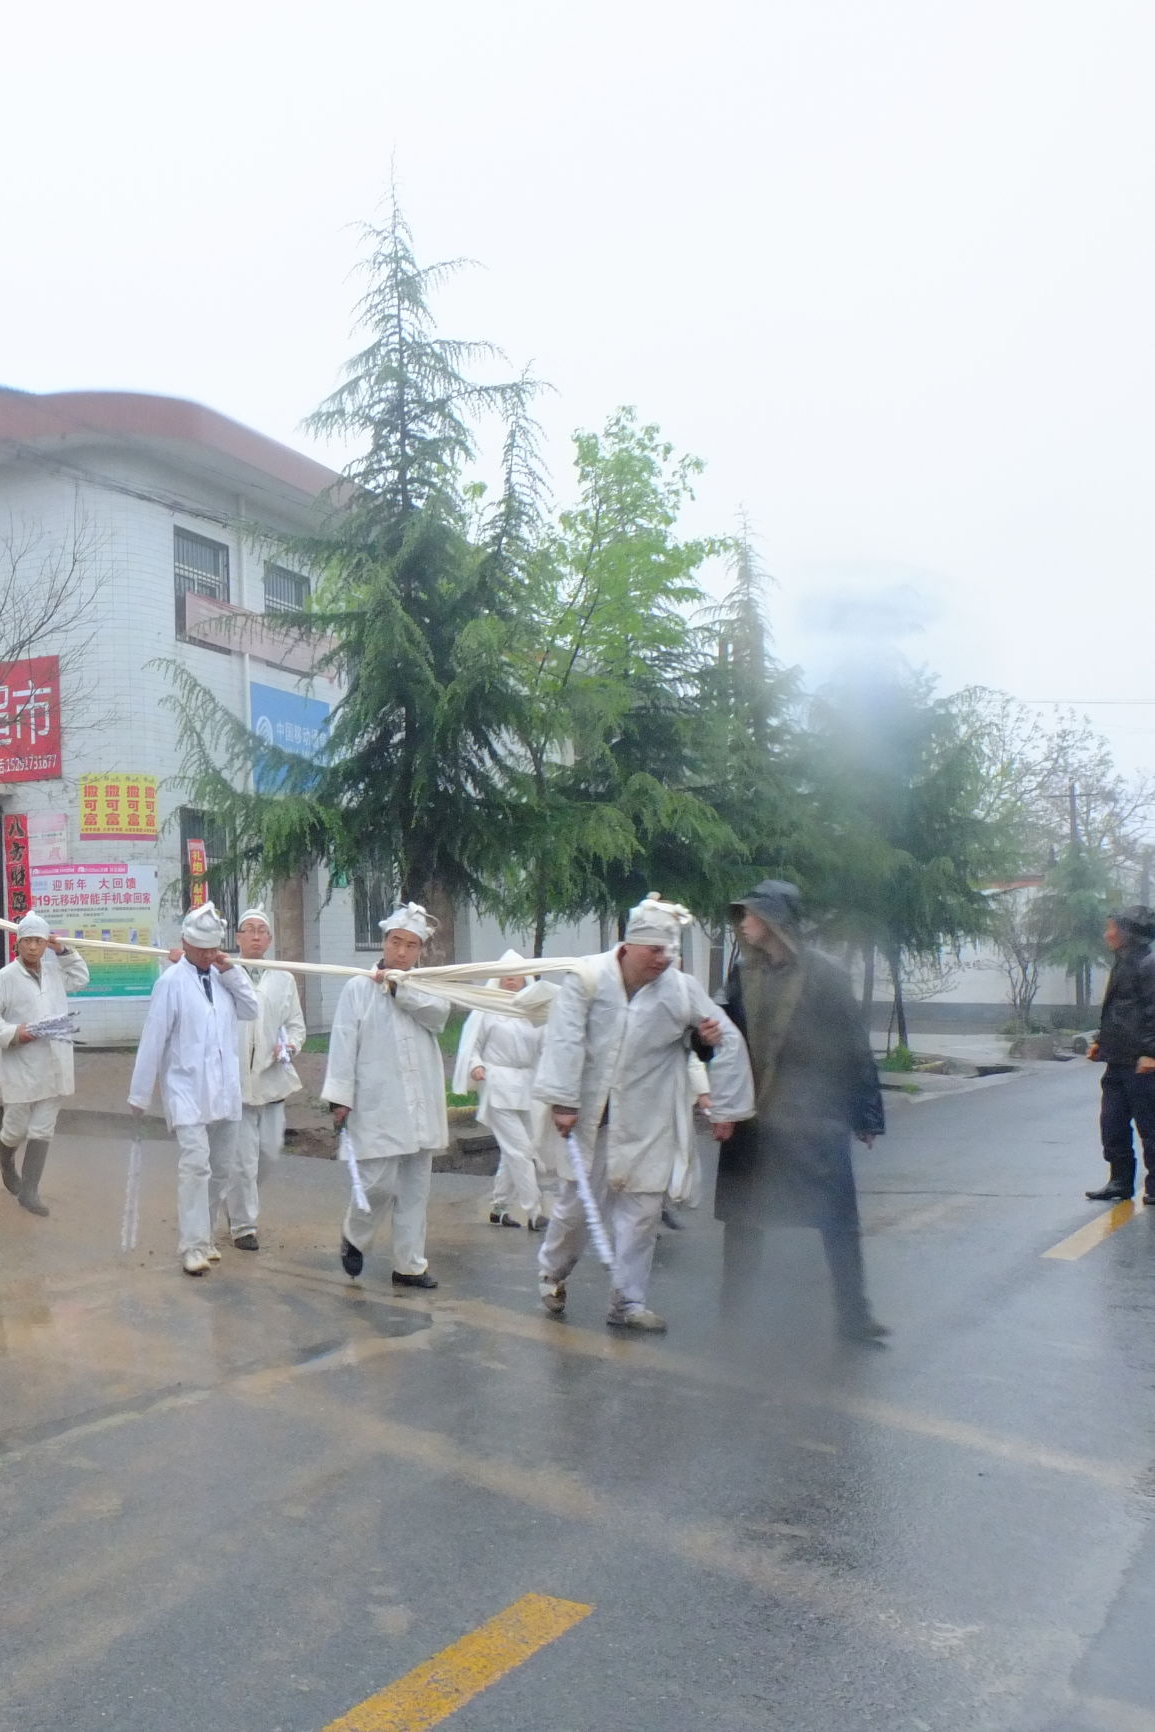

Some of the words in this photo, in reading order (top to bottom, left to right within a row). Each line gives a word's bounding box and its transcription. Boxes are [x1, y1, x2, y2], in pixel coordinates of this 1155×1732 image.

[52, 878, 87, 891] 迎新年
[98, 877, 137, 890] 大回馈
